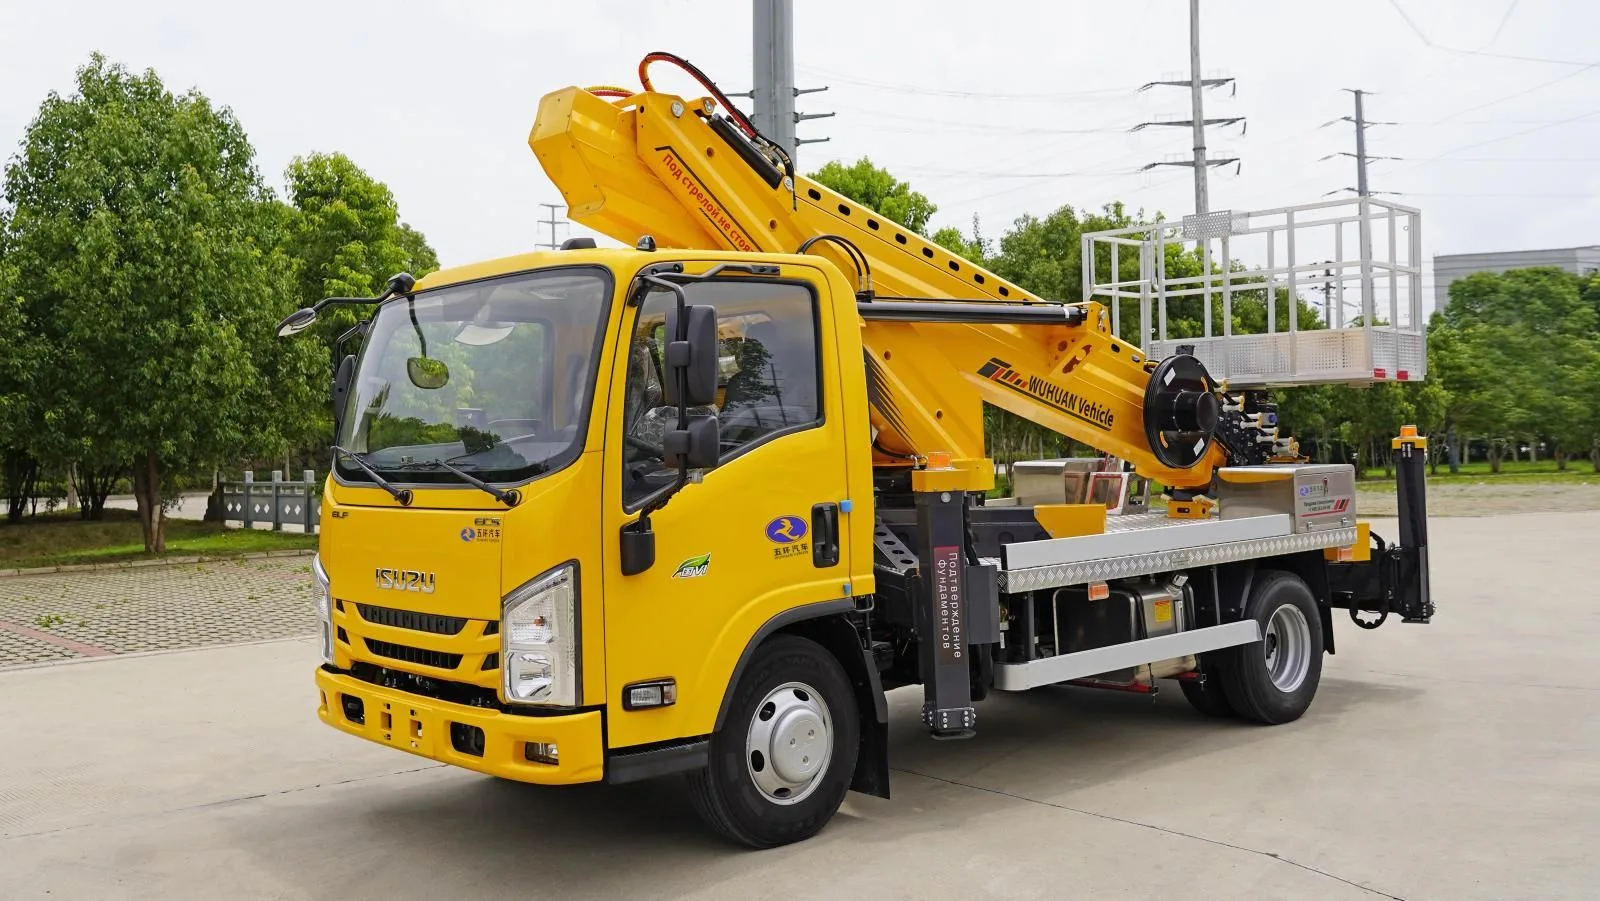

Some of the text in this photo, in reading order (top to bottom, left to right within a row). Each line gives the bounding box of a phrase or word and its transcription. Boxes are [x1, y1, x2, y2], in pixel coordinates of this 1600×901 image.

[662, 154, 754, 252] Под стрелой не стоя
[1028, 375, 1114, 427] WUHUAN Vehicle
[375, 567, 435, 593] ISUZU
[937, 559, 950, 649] фундаментов
[948, 552, 961, 658] Подтверждение
